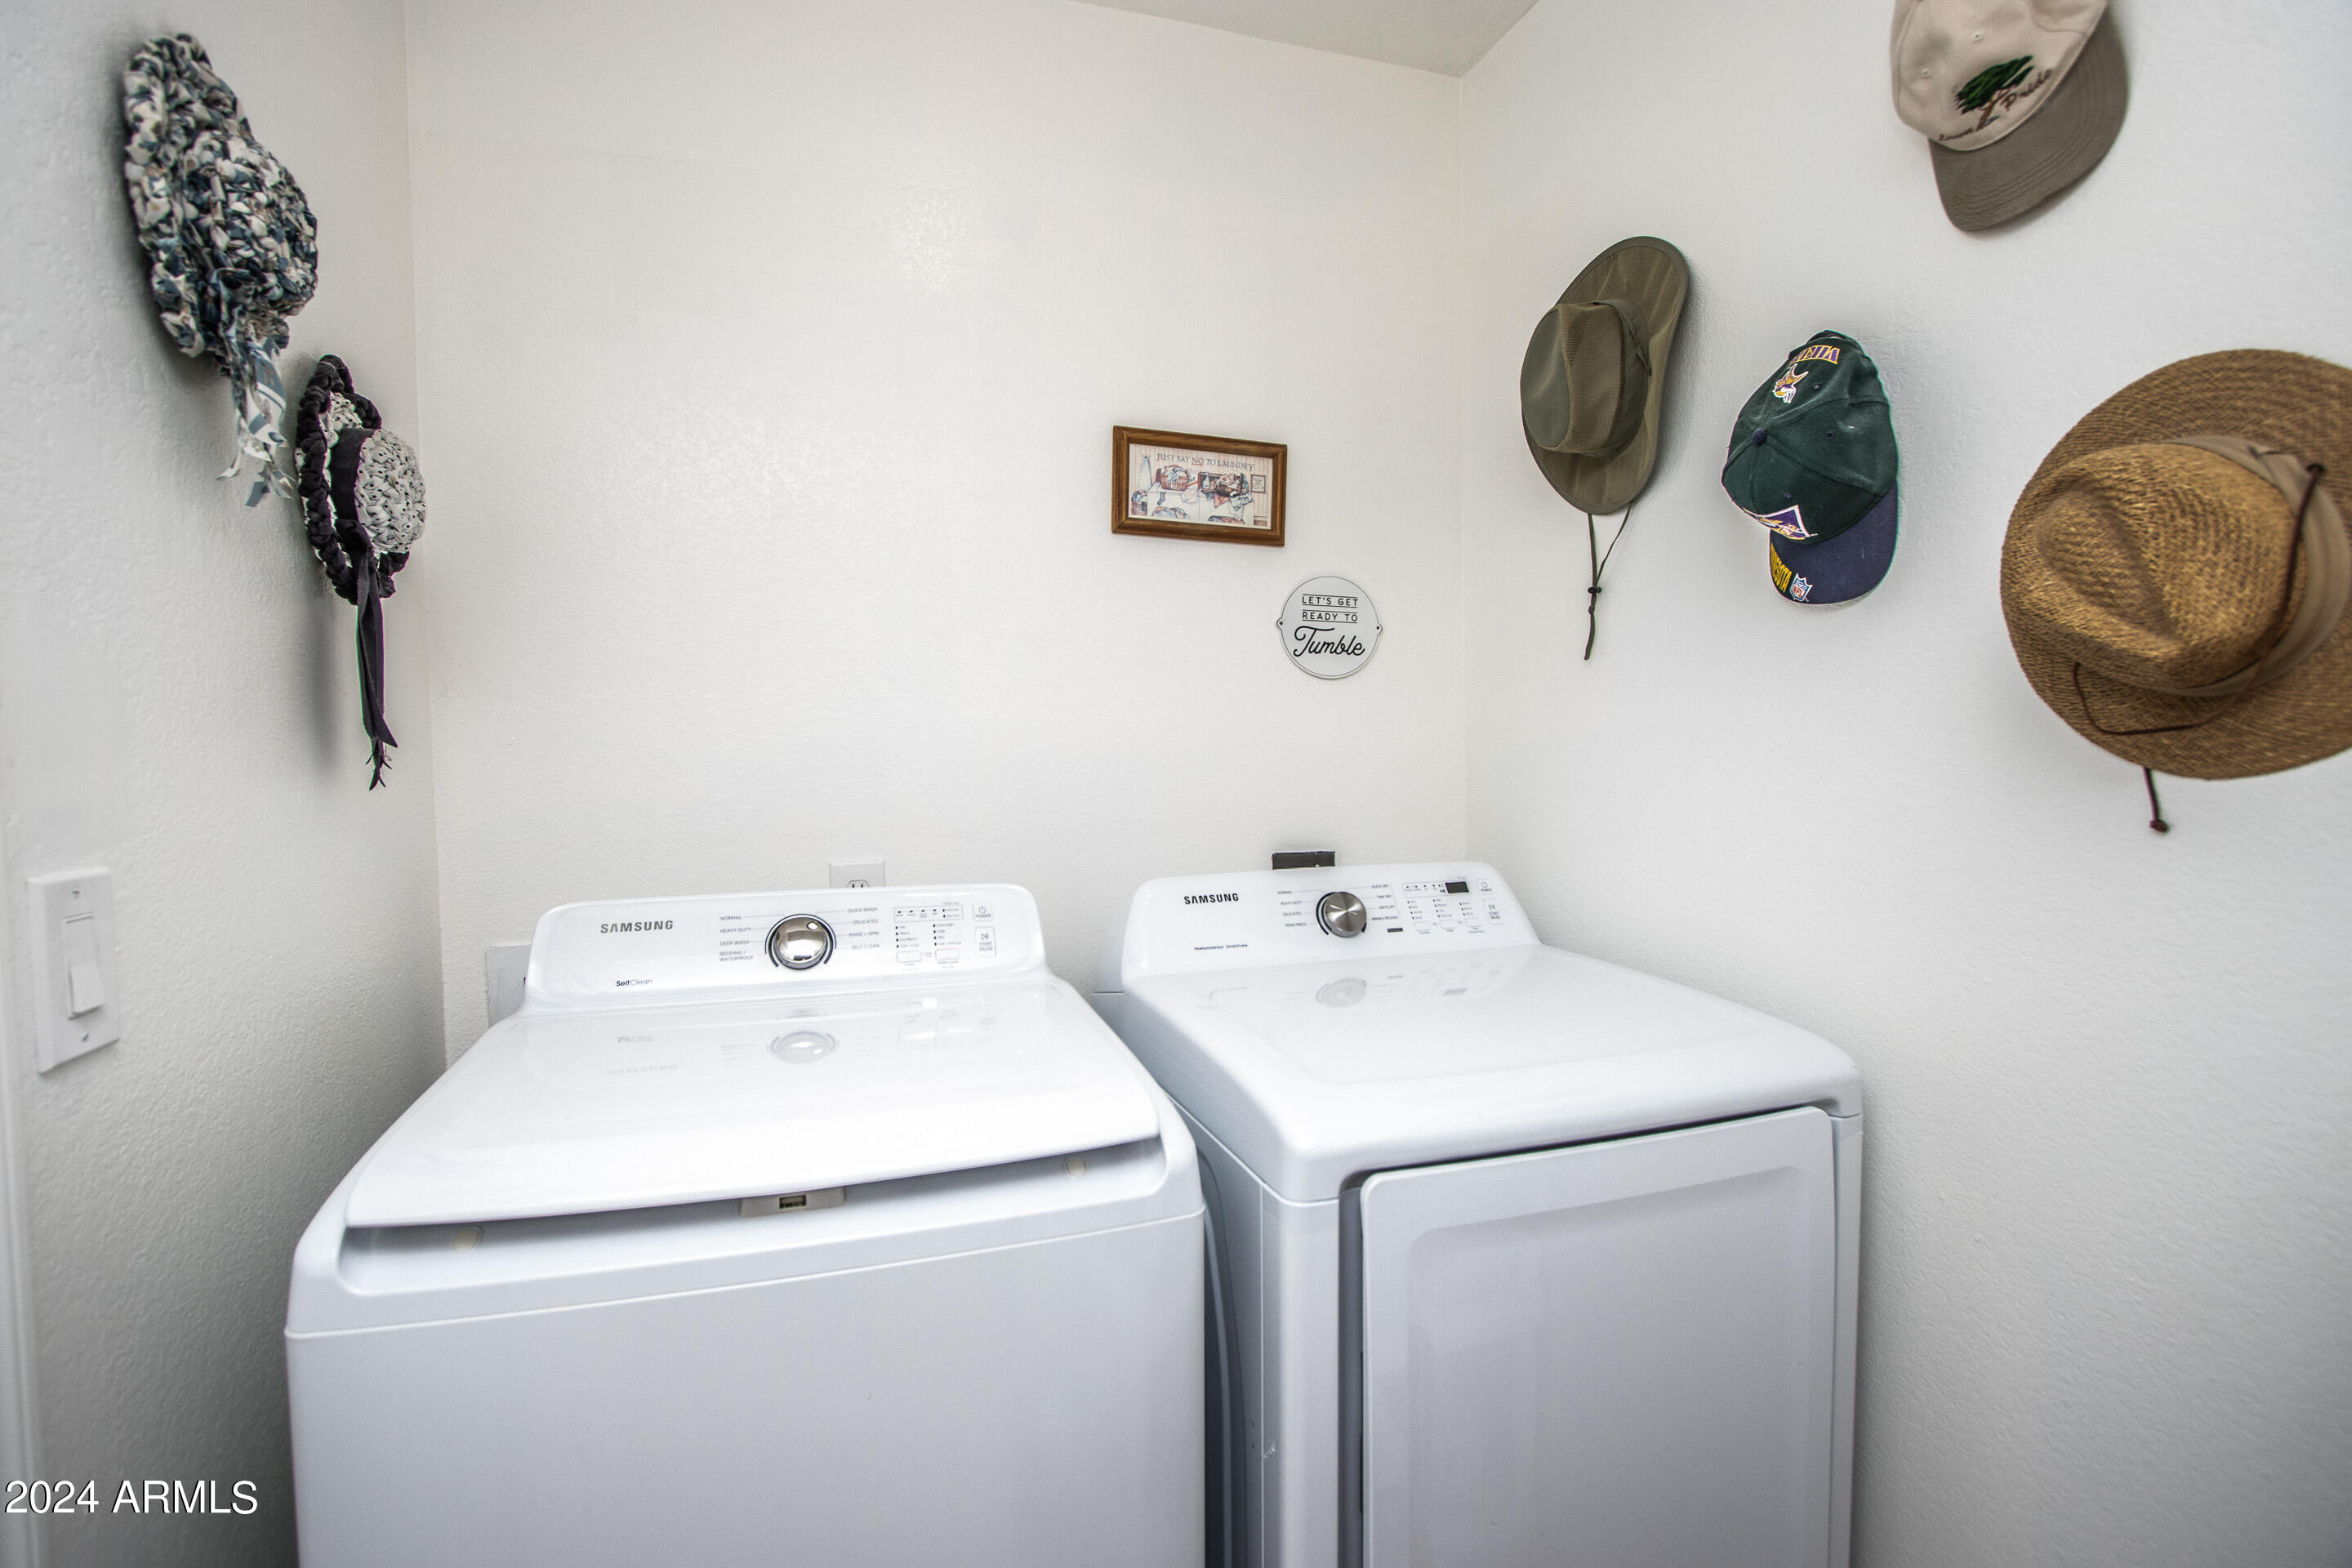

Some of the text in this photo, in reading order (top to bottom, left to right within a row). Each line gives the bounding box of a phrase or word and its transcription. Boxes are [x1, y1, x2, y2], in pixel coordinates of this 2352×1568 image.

[1156, 453, 1174, 461] JUST
[1176, 455, 1190, 463] SAY
[1192, 457, 1205, 465] NO
[1217, 460, 1254, 471] LAUNDRY
[1302, 596, 1359, 607] LET'S GET
[1302, 611, 1358, 622] READY TO
[1293, 625, 1365, 657] Tumble
[1183, 893, 1240, 905] SAMSUNG
[600, 920, 674, 933] SAMSUNG
